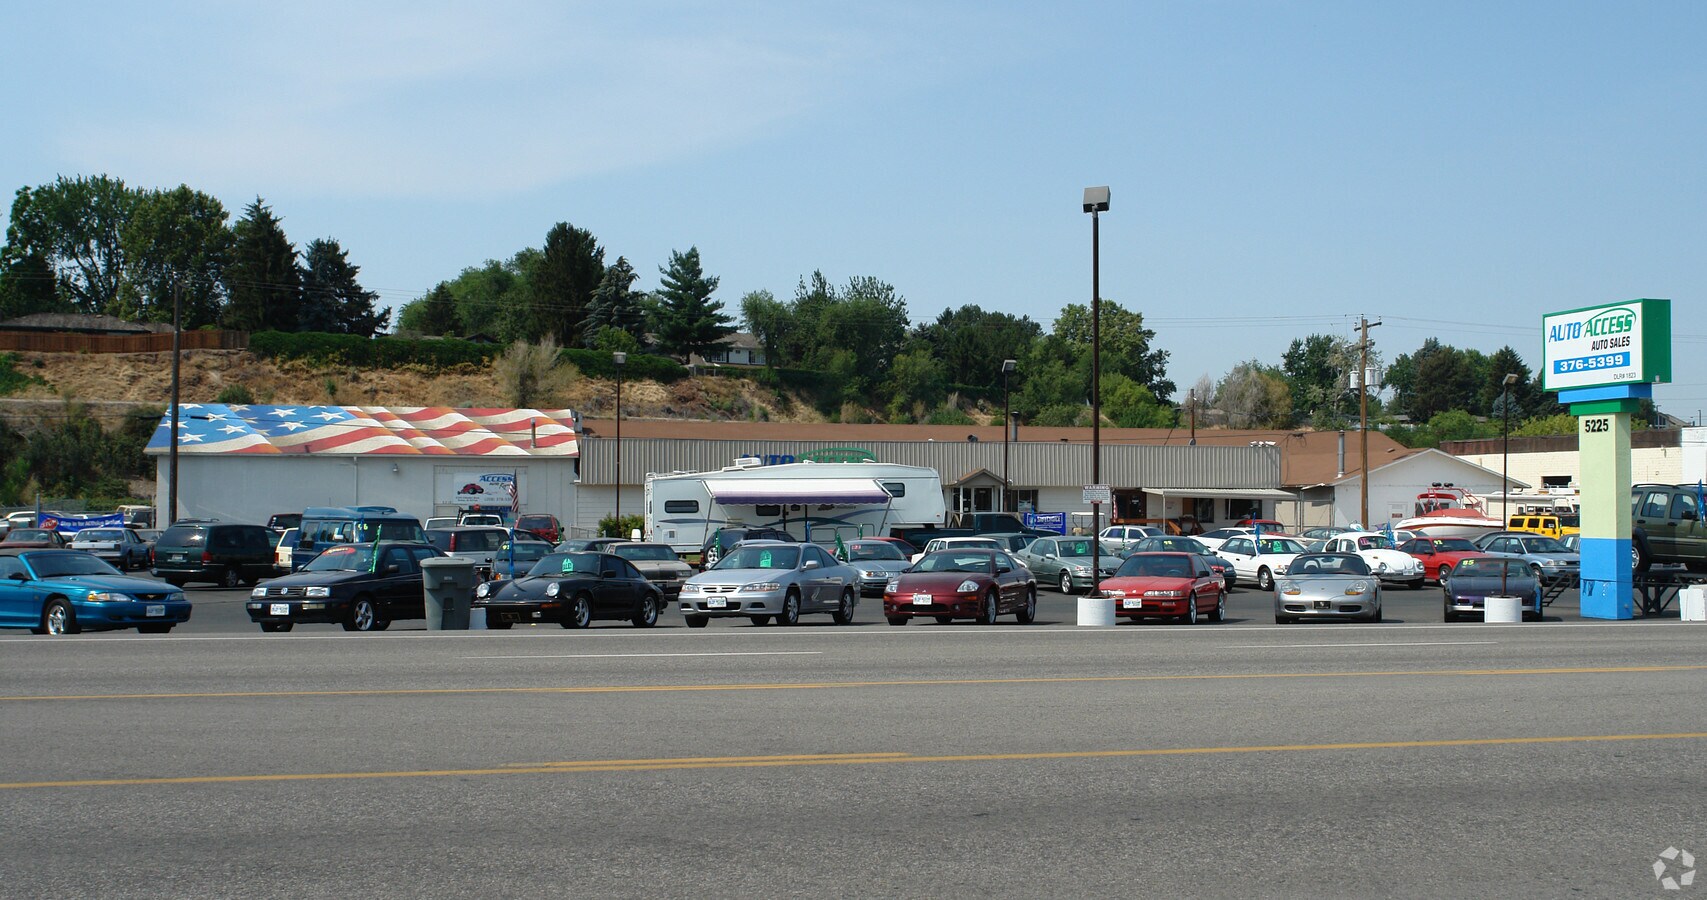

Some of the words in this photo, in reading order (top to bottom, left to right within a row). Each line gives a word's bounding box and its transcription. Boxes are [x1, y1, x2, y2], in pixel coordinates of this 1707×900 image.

[1549, 322, 1582, 342] AUTO
[1584, 314, 1633, 337] ACCESS
[1591, 339, 1608, 351] AUTO
[1610, 336, 1631, 348] SALES
[1560, 355, 1624, 371] 376-5399
[1584, 418, 1609, 433] 5225
